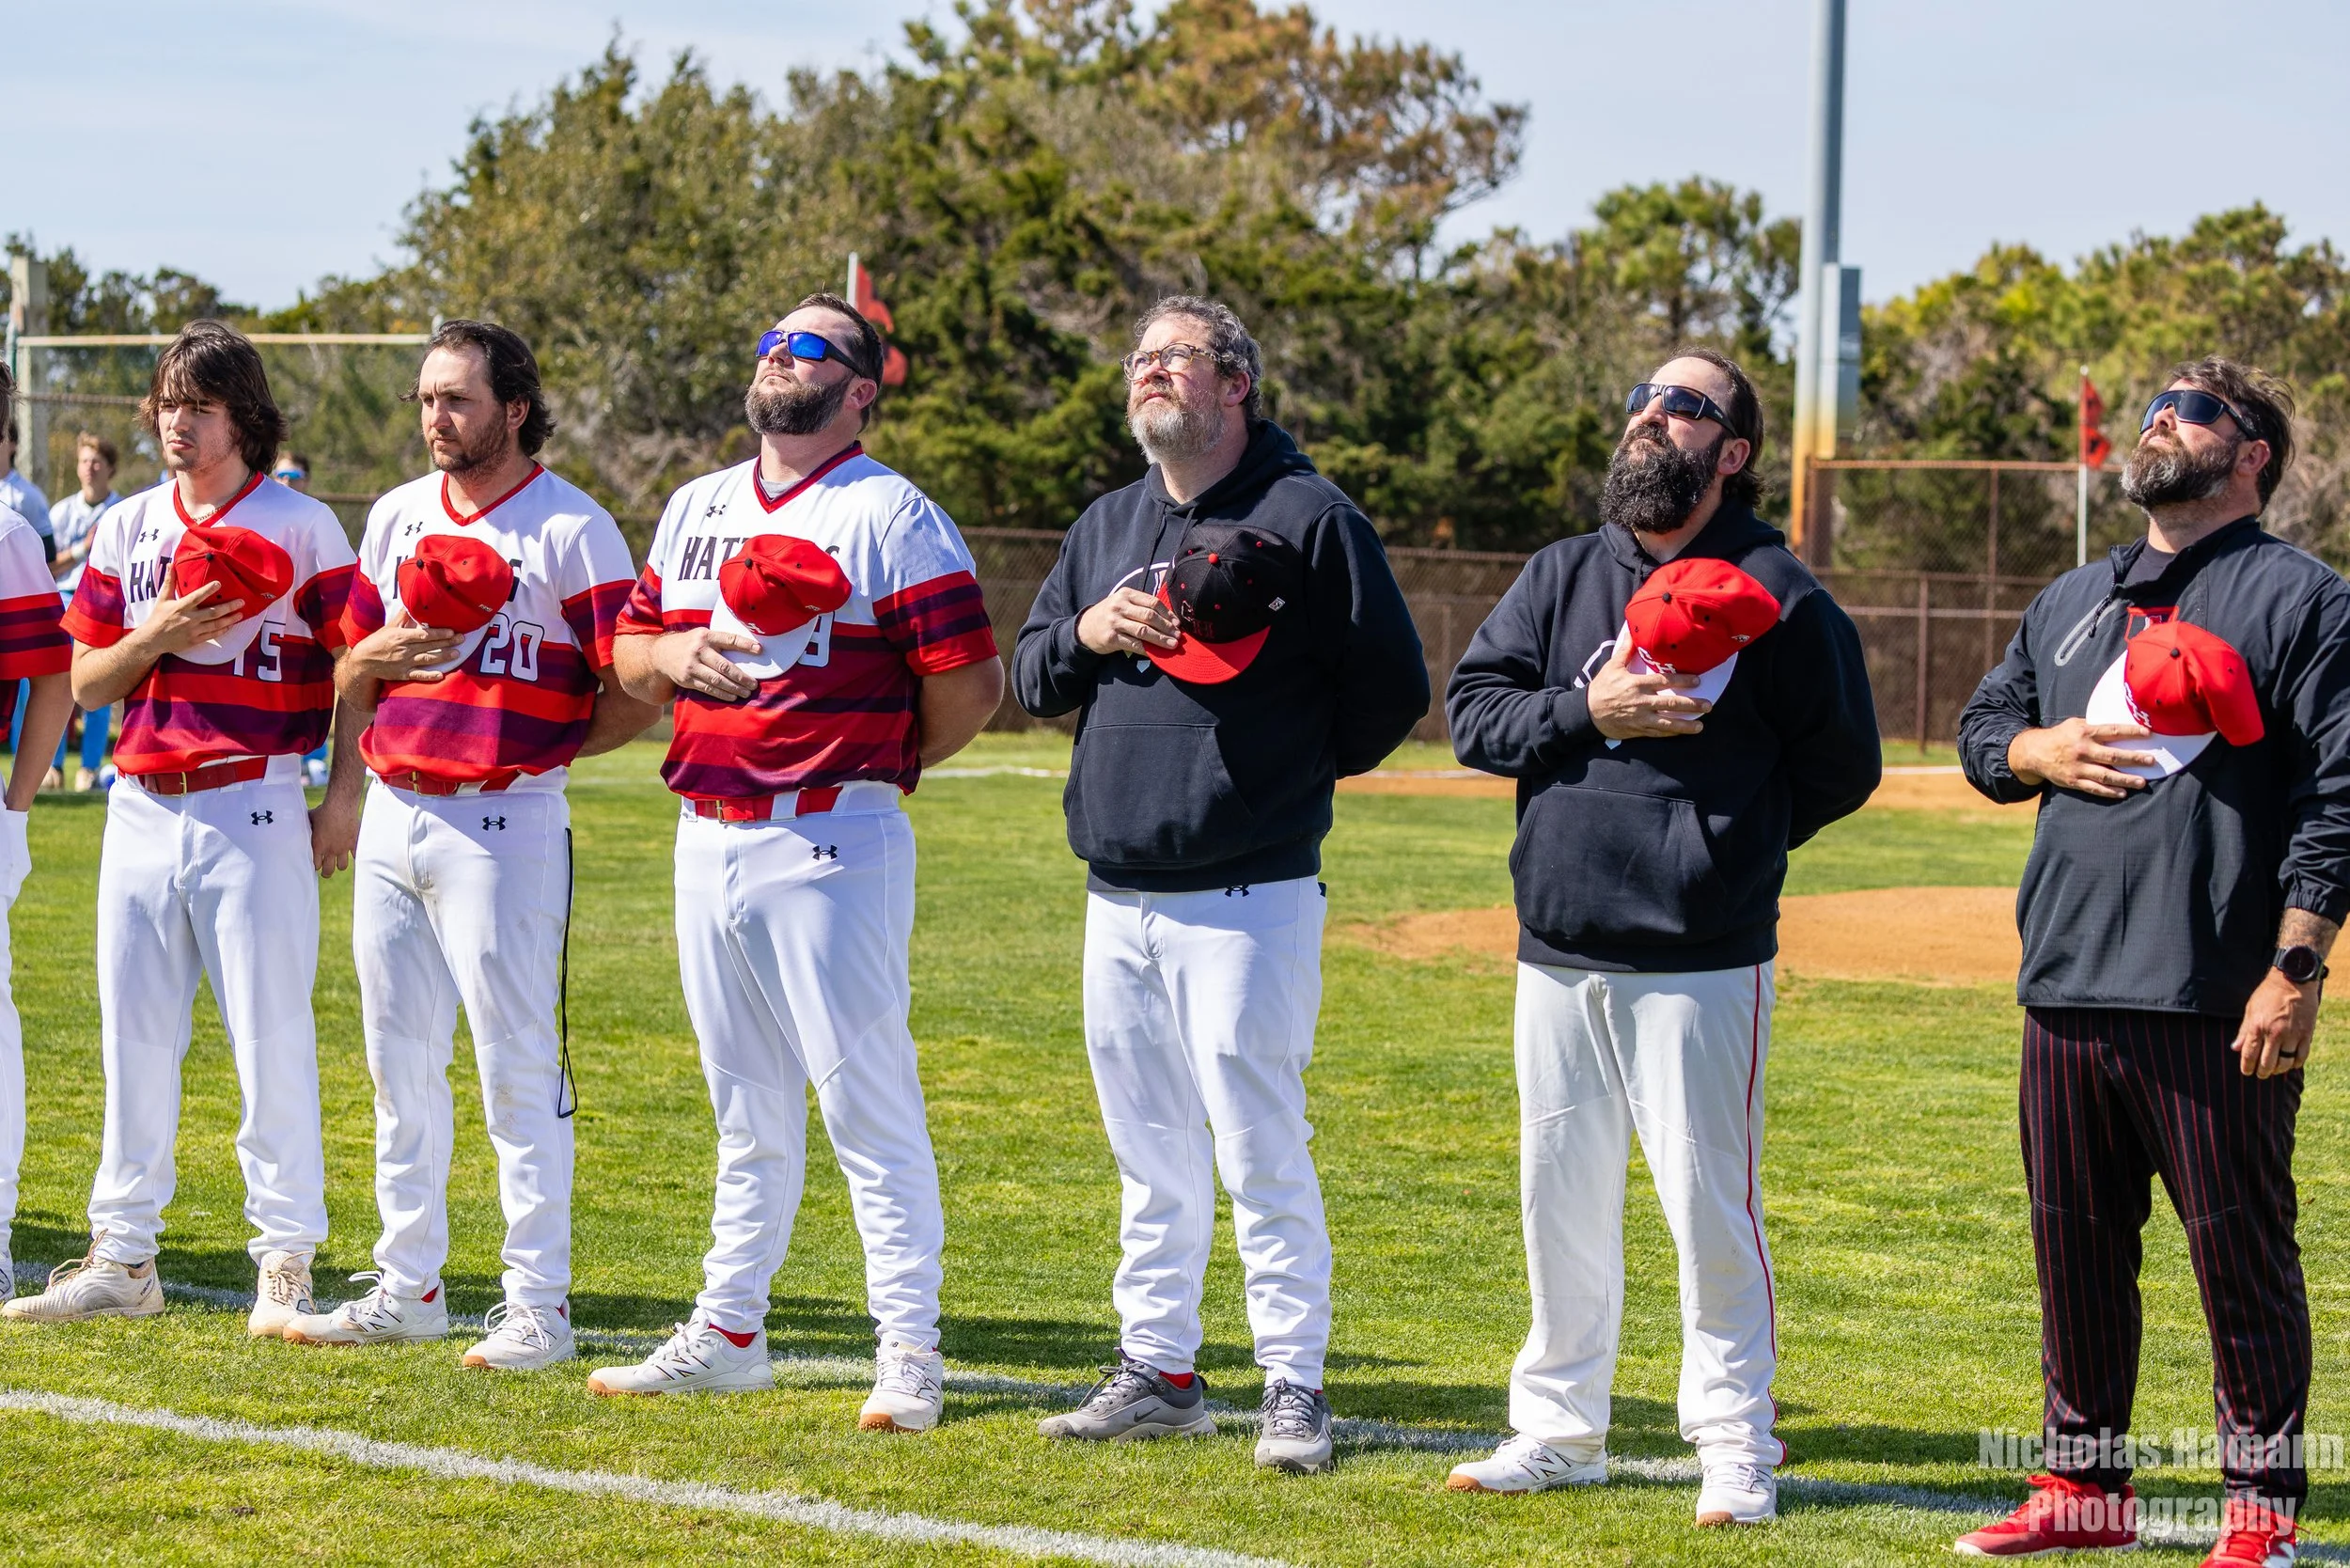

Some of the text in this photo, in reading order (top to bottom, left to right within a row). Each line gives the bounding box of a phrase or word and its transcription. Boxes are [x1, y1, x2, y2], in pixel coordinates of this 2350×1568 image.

[130, 557, 173, 604] HAT
[678, 537, 751, 581] HAT
[479, 612, 545, 682] 20
